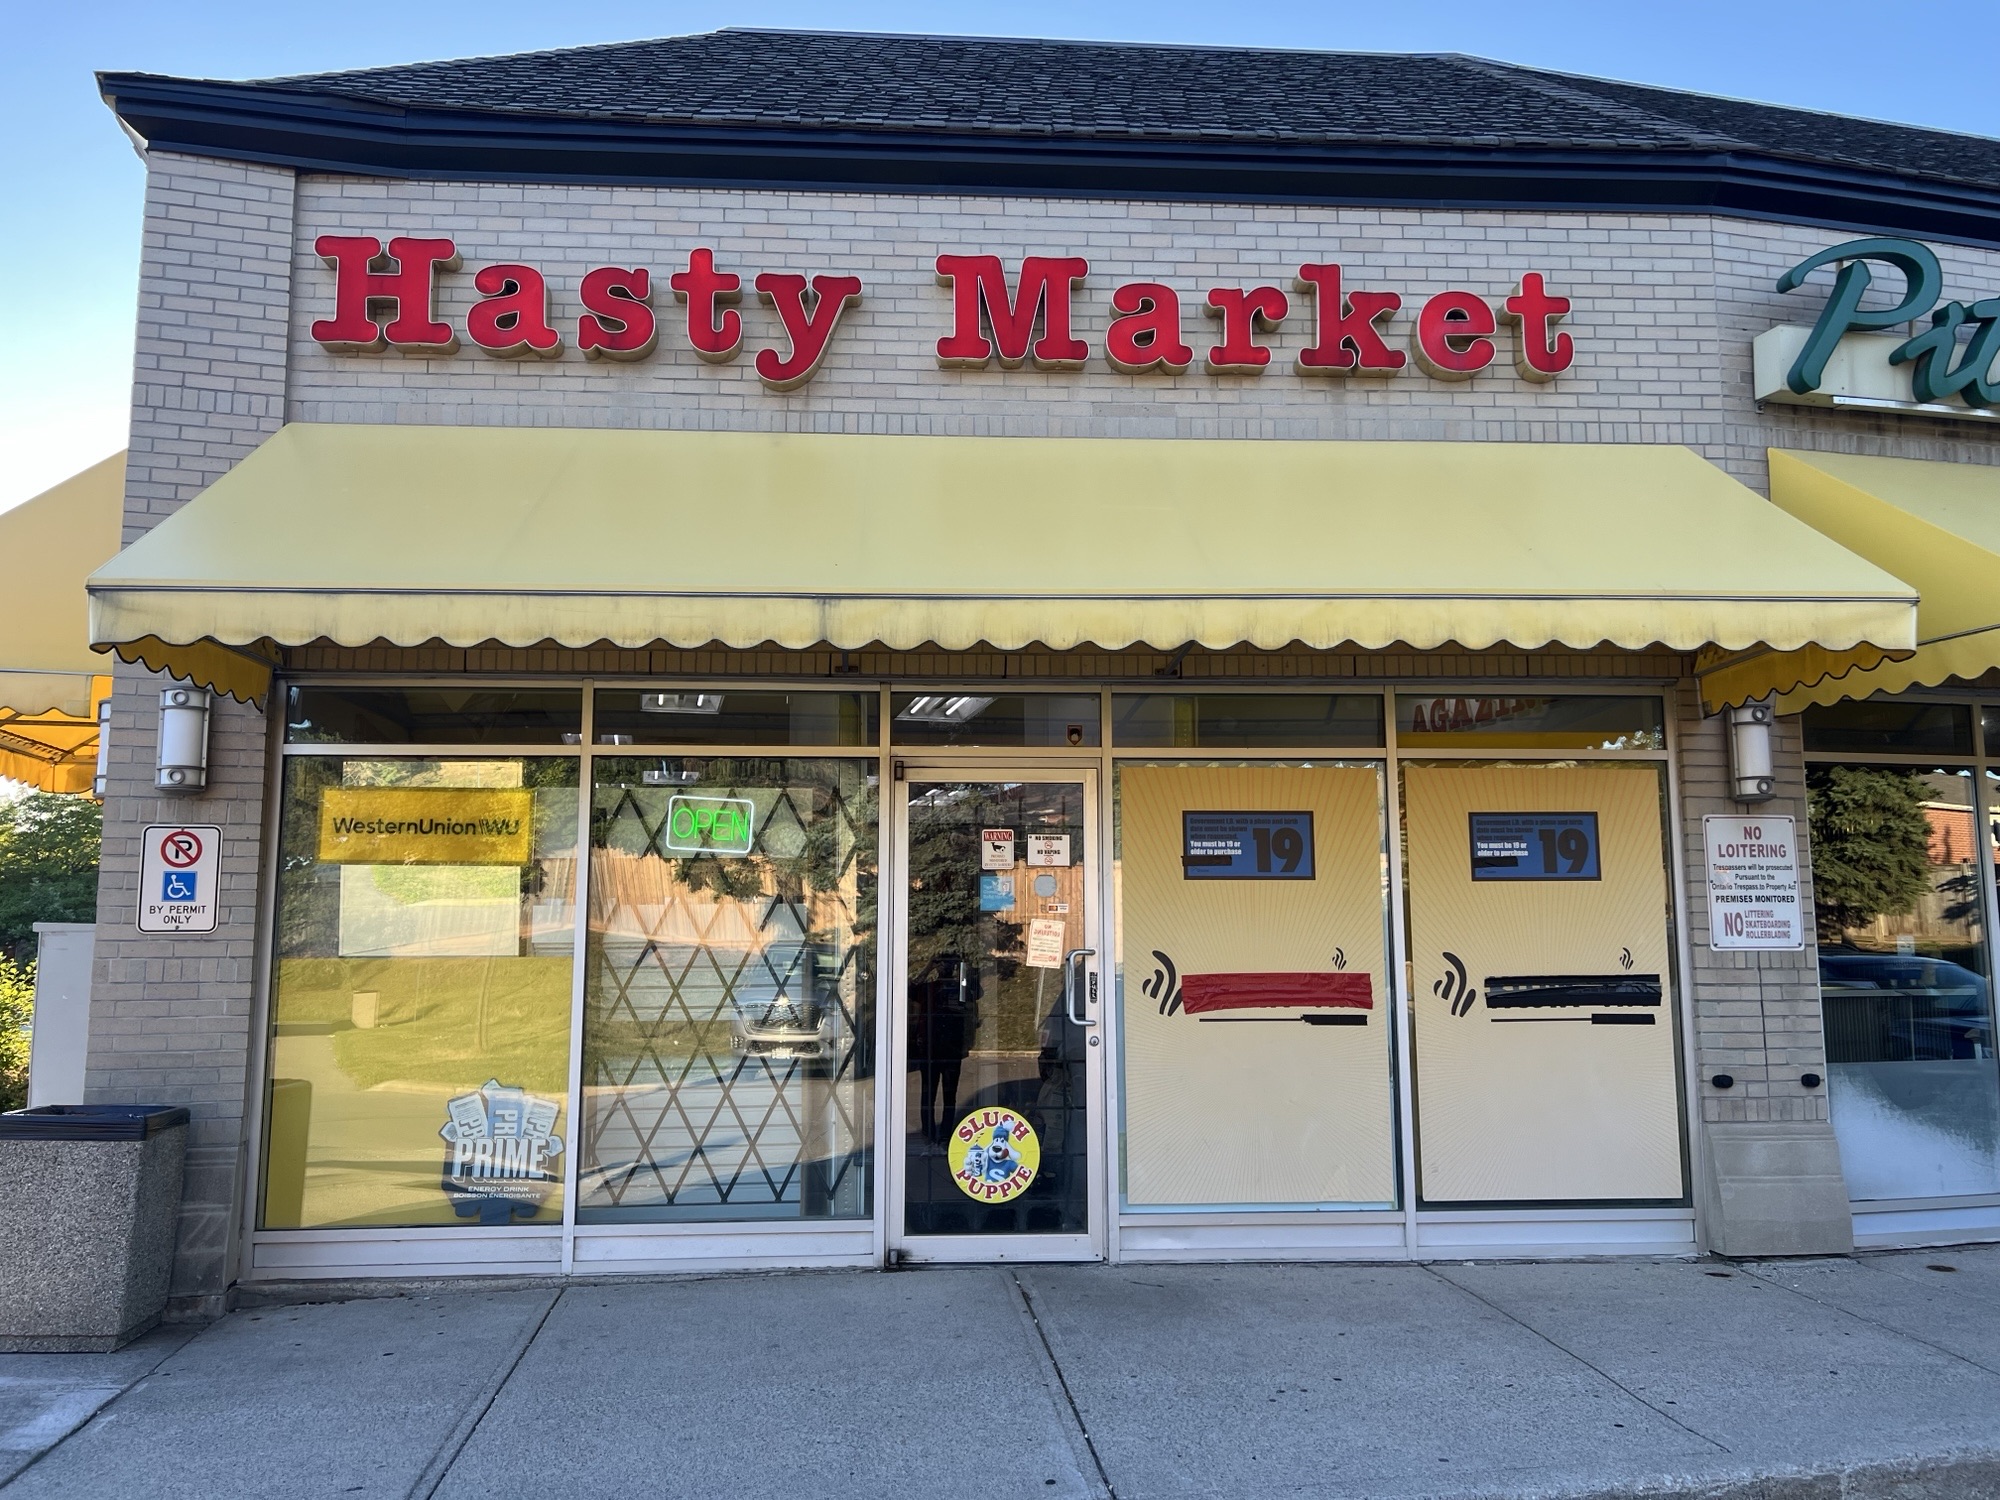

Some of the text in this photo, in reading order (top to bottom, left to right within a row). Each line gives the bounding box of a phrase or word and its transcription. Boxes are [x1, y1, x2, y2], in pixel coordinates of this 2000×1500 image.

[311, 235, 1575, 389] Hasty Market
[672, 807, 749, 842] OPEN
[984, 831, 1012, 841] WARNING
[1743, 826, 1762, 840] NO
[1252, 827, 1303, 872] 19
[1538, 828, 1589, 873] 19
[1718, 844, 1787, 858] LOITERING
[1713, 864, 1746, 872] Trespassers
[1766, 864, 1793, 872] prosecuted
[1734, 883, 1759, 891] Trespass
[1766, 883, 1787, 891] Property
[1715, 895, 1795, 903] PREMISES MONITORED
[149, 905, 207, 914] BY PERMIT
[163, 915, 192, 924] ONLY
[1724, 910, 1774, 937] NO LITTERING
[1745, 920, 1791, 928] SKATEBOARDING
[1746, 930, 1791, 939] ROLLERBLADING
[452, 1138, 547, 1180] PRIME
